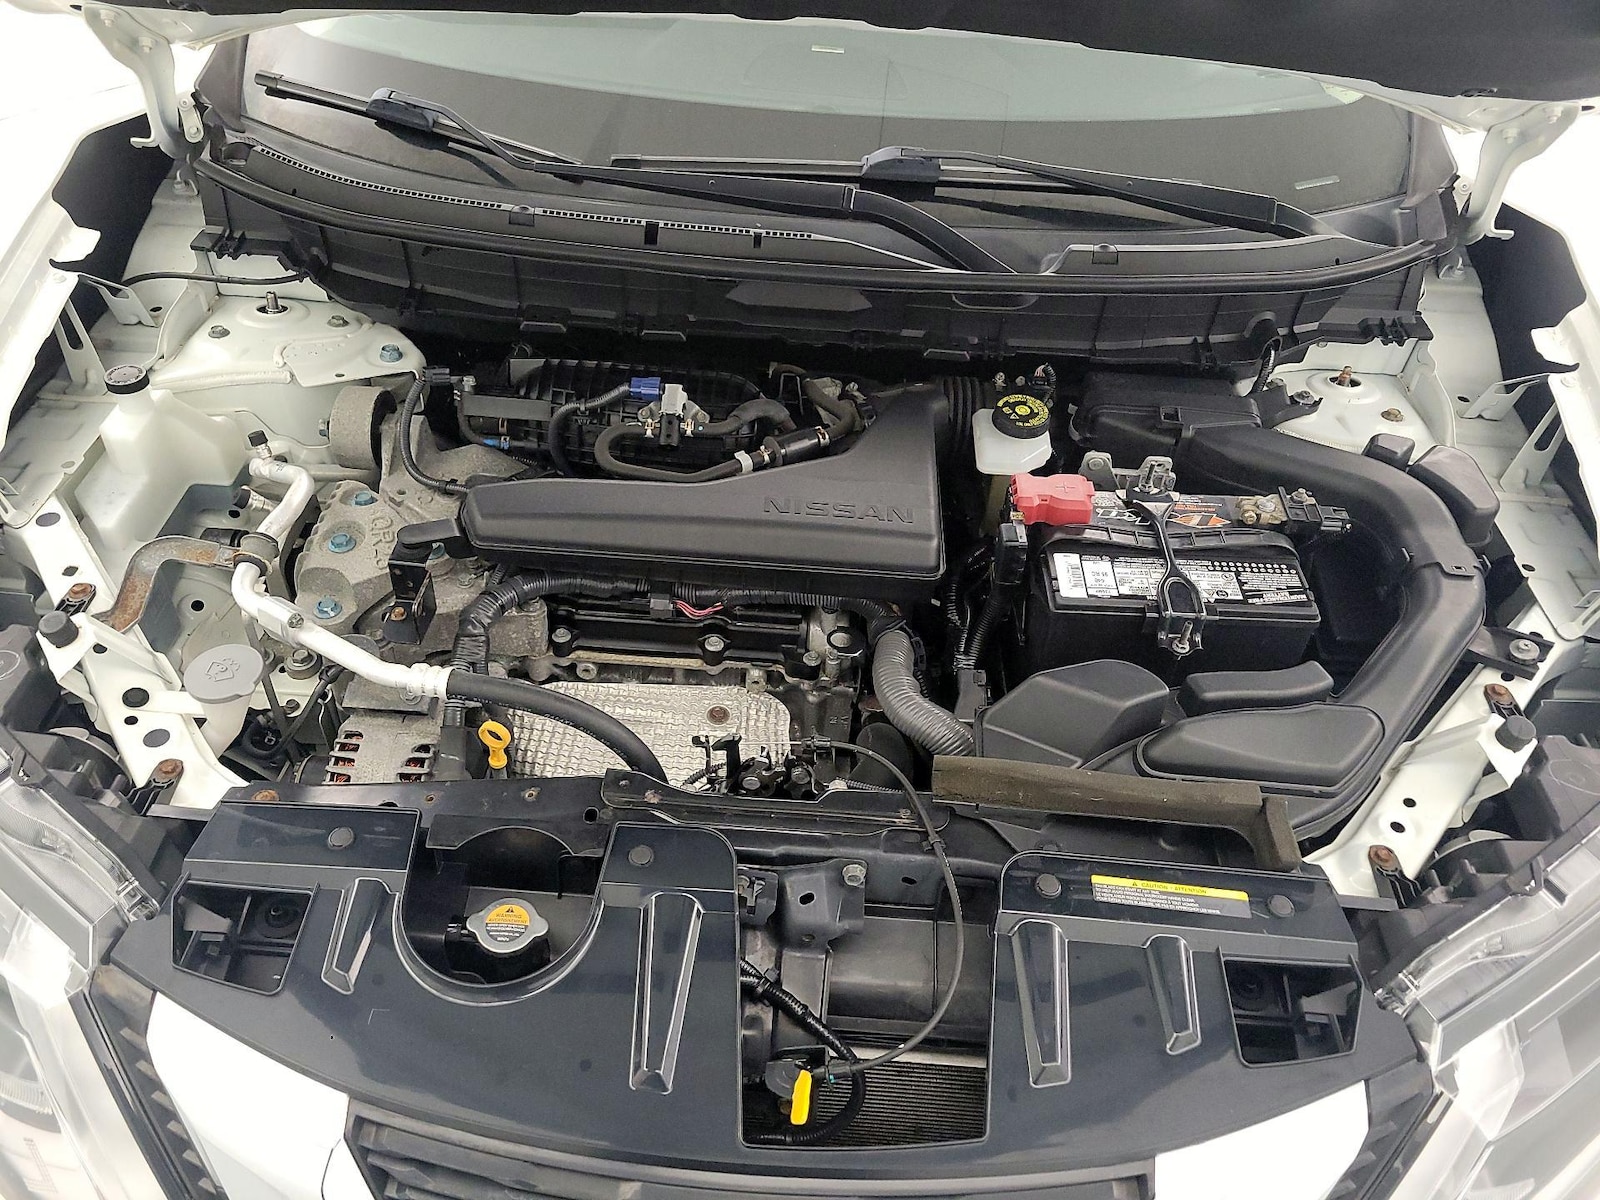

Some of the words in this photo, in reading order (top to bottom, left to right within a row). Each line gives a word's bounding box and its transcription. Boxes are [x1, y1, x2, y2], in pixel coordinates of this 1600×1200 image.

[763, 495, 915, 524] NISSAN
[1141, 882, 1168, 890] CAUTION
[1175, 886, 1207, 894] ATTENTION
